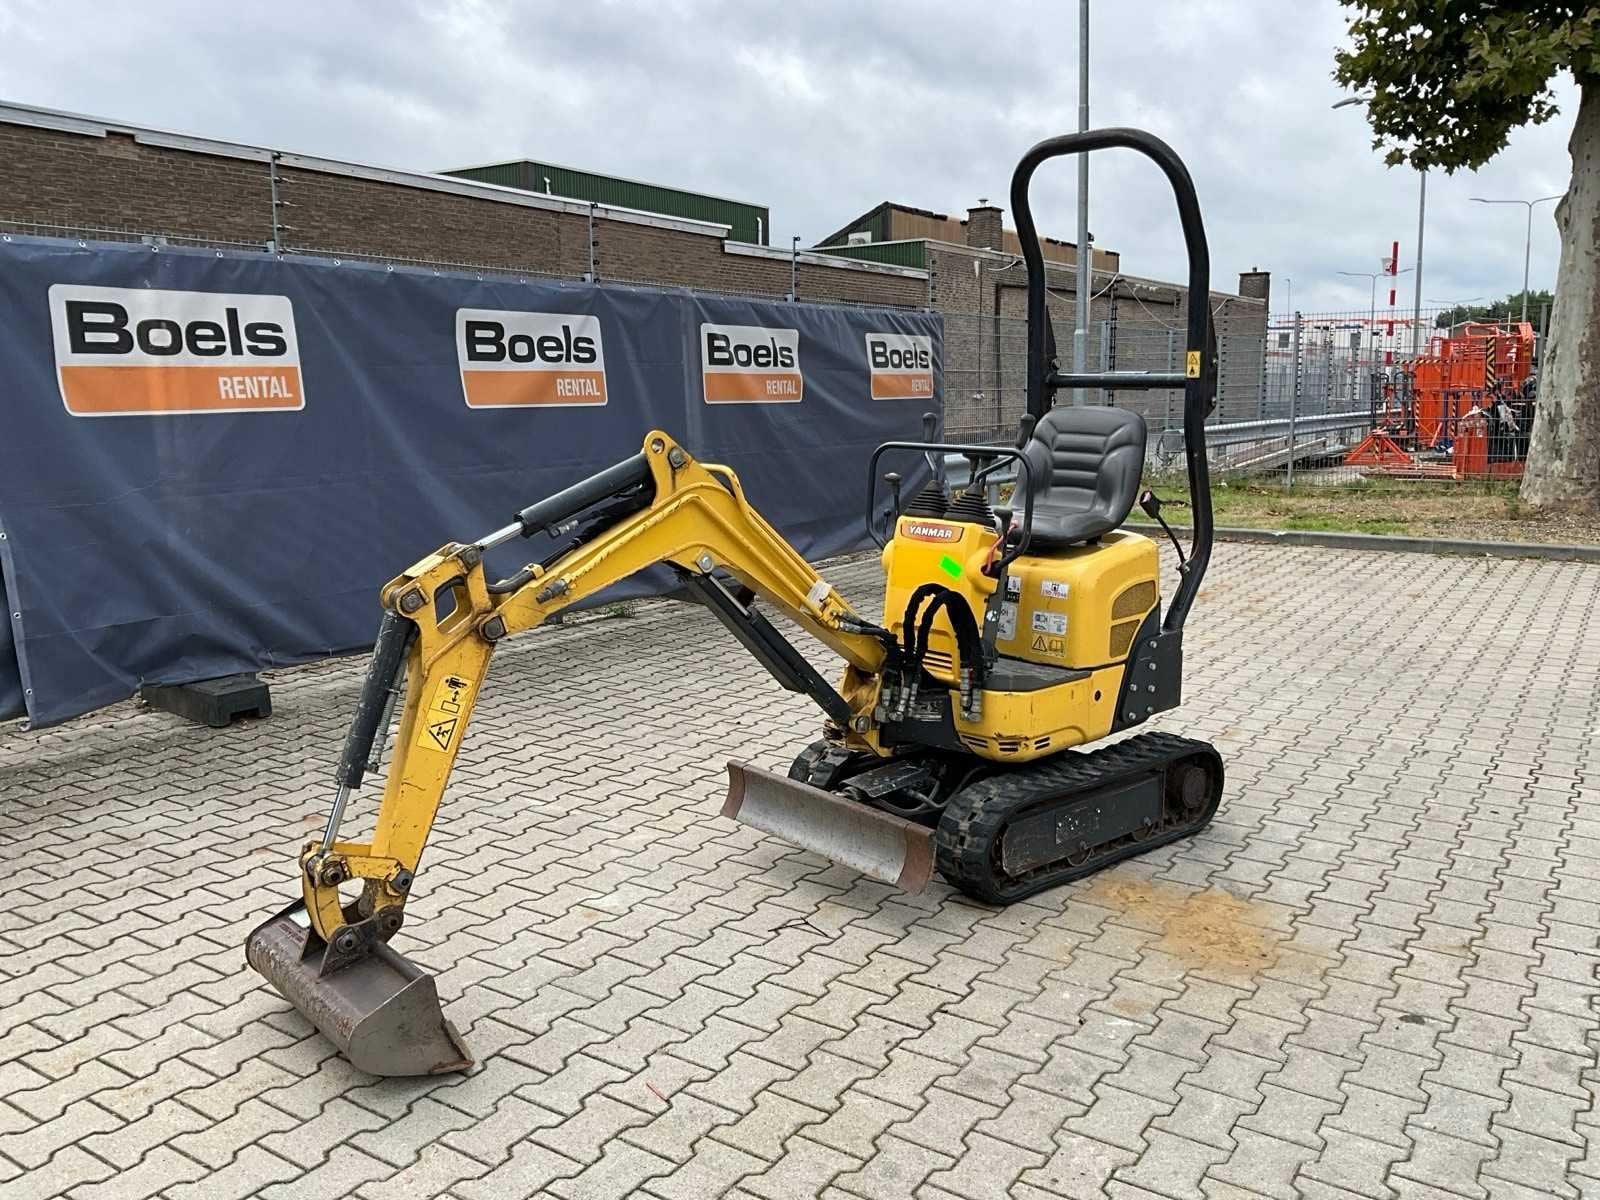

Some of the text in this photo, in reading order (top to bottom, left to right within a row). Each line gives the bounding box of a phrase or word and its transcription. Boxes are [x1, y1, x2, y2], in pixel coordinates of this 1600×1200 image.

[65, 300, 287, 356] Boels
[466, 321, 596, 363] Boels
[707, 333, 794, 368] Boels
[872, 342, 930, 369] Boels
[218, 376, 293, 400] RENTAL
[557, 378, 600, 397] RENTAL
[766, 380, 798, 395] RENTAL
[911, 379, 931, 392] RENTAL
[909, 526, 953, 538] YANMAR
